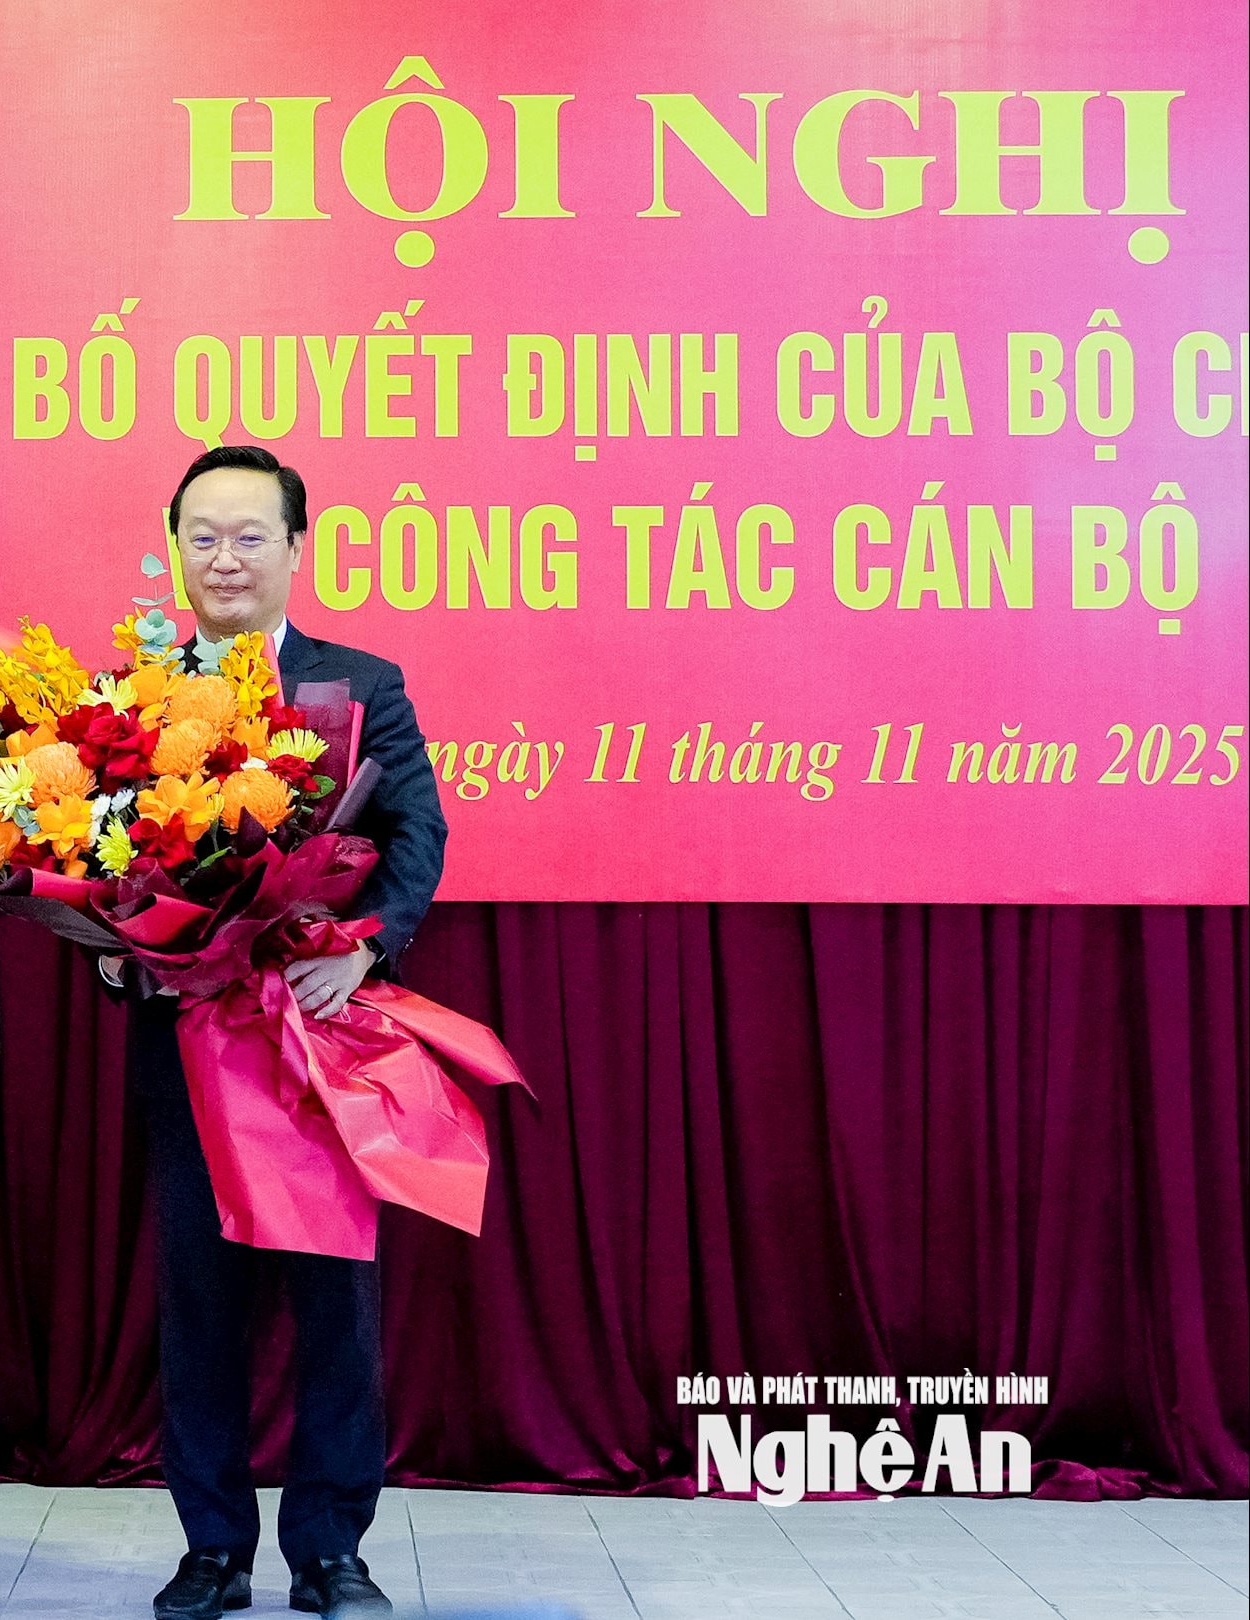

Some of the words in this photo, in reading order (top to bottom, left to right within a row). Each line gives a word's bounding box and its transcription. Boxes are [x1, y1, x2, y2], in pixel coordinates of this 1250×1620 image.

[172, 55, 576, 268] HỘI
[635, 88, 1187, 265] NGHỊ
[13, 297, 142, 441] BỐ
[173, 299, 473, 453] QUYẾT
[502, 333, 739, 462] ĐỊNH
[776, 295, 974, 438] CỦA
[1007, 308, 1135, 461] BỘ
[1172, 330, 1248, 438] C
[313, 482, 578, 611] CÔNG
[612, 481, 795, 611] TÁC
[832, 481, 1034, 611] CÁN
[1071, 481, 1199, 635] BỘ
[424, 721, 564, 800] ngày
[585, 722, 646, 782] 11
[669, 721, 842, 801] tháng
[861, 722, 924, 783] 11
[946, 723, 1077, 784] năm
[1097, 723, 1244, 786] 2025
